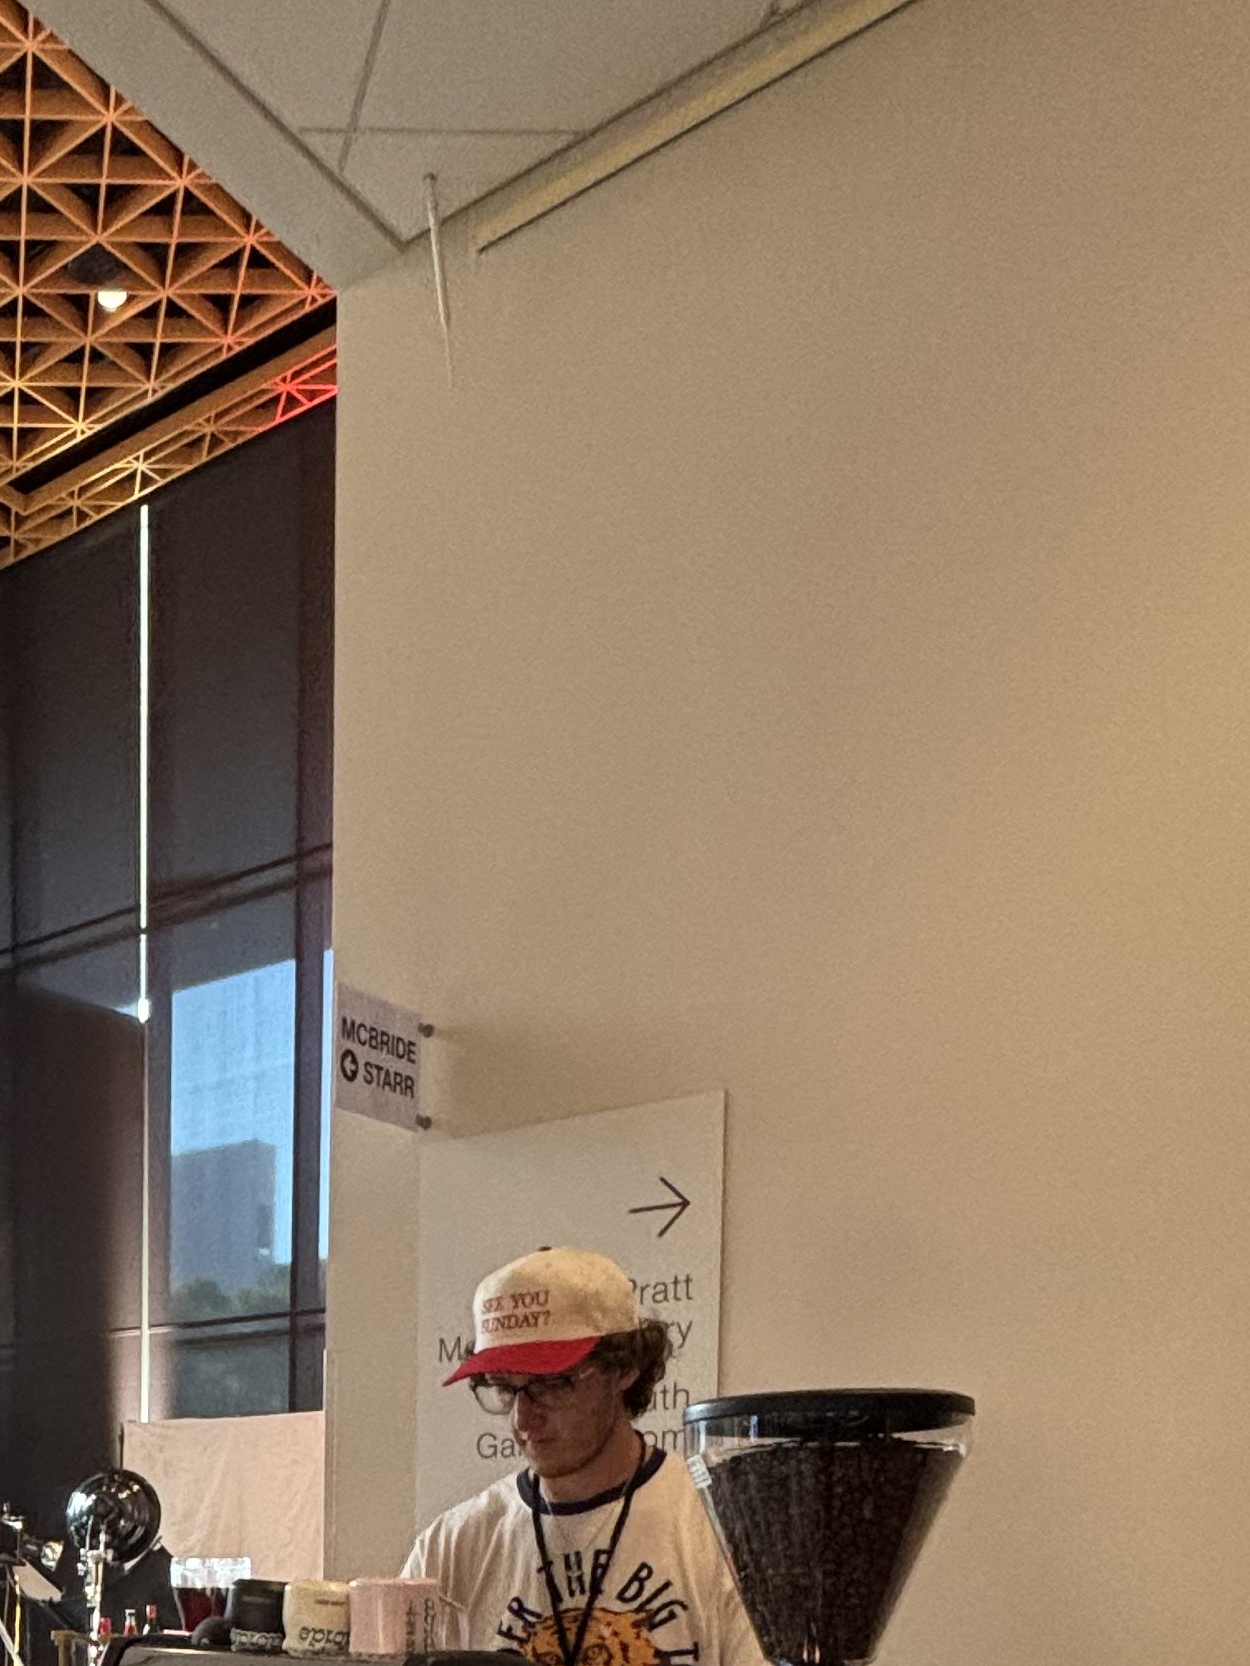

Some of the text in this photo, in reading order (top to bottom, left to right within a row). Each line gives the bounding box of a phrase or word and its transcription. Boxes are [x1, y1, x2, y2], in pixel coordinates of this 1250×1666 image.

[341, 1016, 417, 1064] MCBRIDE
[362, 1061, 415, 1099] STARR
[510, 1289, 550, 1310] YOU
[616, 1562, 690, 1632] BIG
